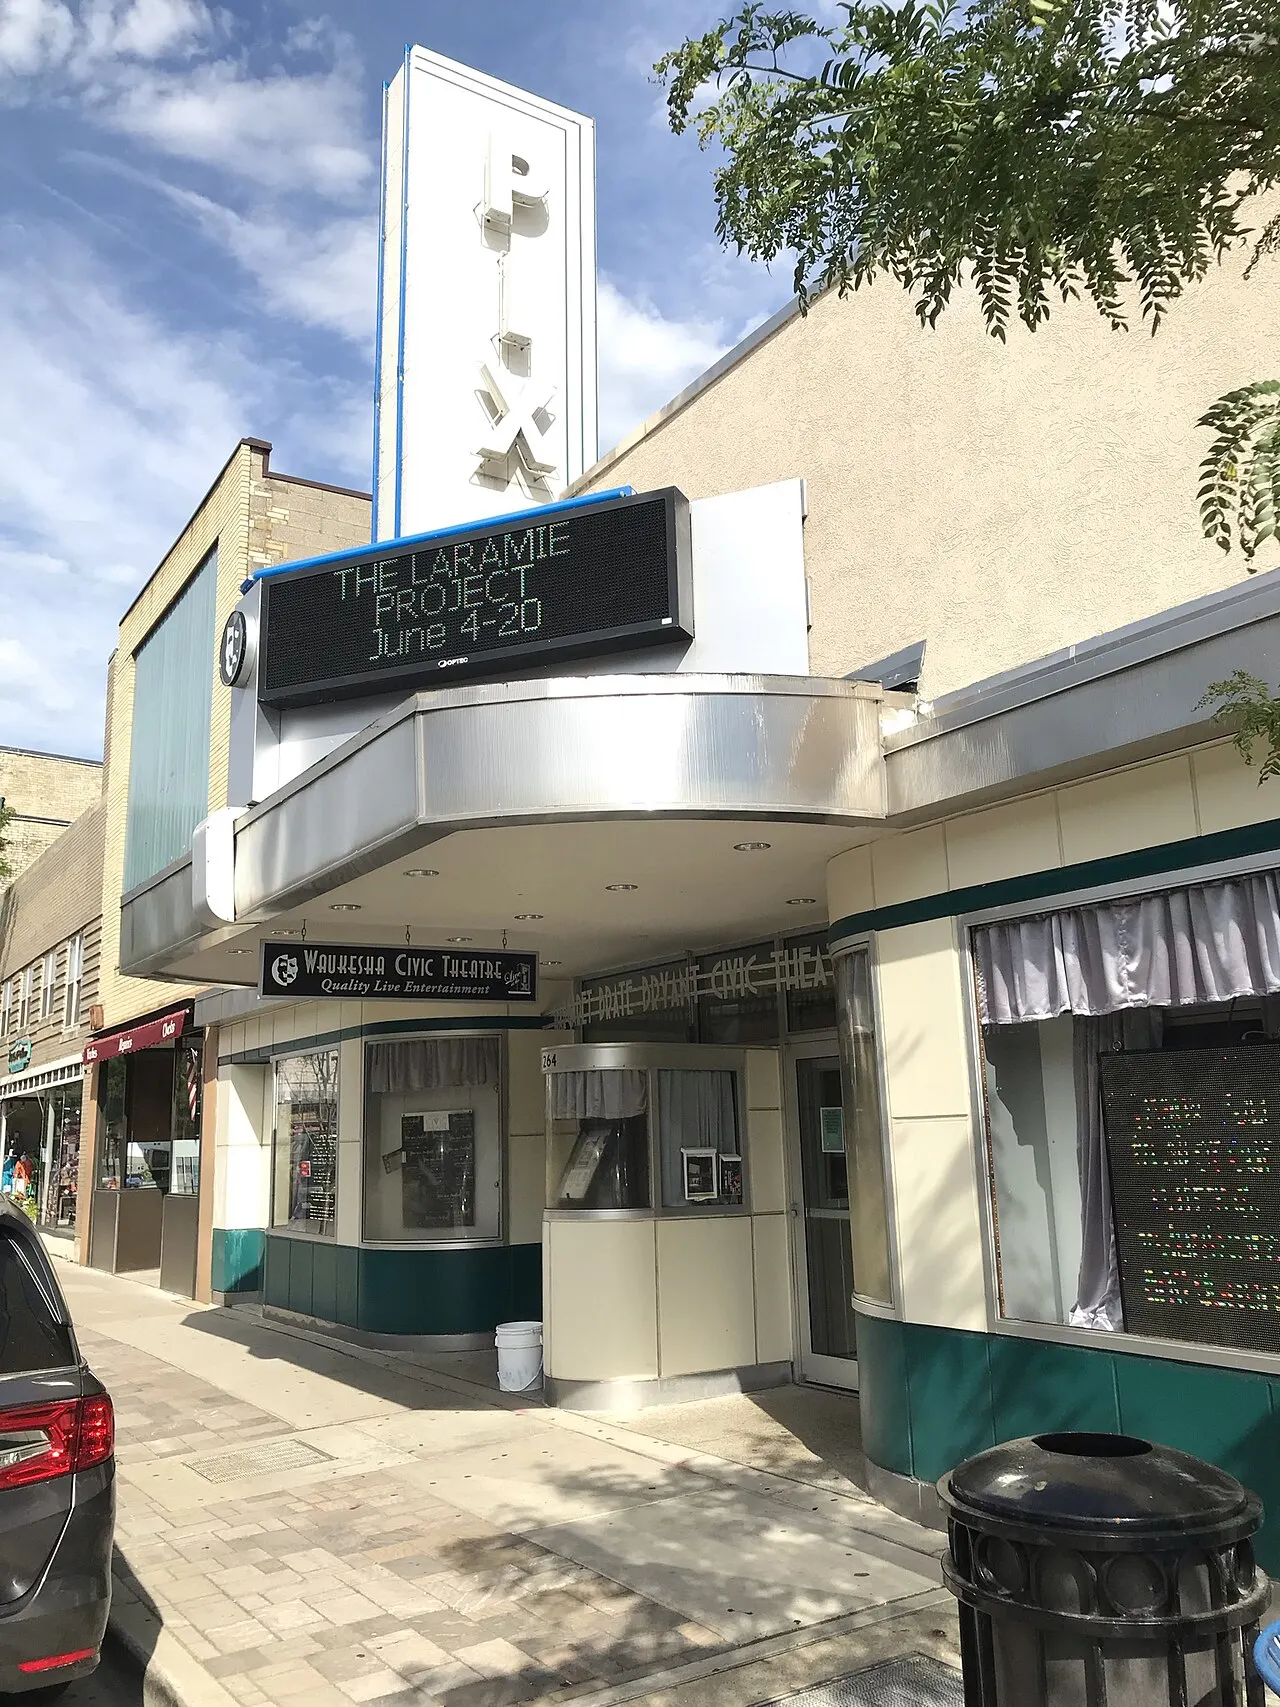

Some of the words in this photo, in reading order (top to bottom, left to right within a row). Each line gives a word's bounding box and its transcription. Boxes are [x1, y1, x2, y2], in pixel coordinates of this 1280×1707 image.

[334, 559, 398, 600] THE
[412, 522, 570, 585] LARAMIE
[375, 563, 535, 625] PROJECT
[369, 626, 447, 660] June
[460, 597, 542, 641] 4-20
[447, 657, 469, 666] OPTEC
[321, 978, 371, 994] Quality
[373, 980, 401, 993] Live
[403, 982, 491, 995] Entertainment
[394, 953, 434, 977] CIVIC
[441, 955, 502, 980] THEATRE
[711, 954, 758, 1000] CIVIC
[770, 944, 830, 992] THEA
[542, 1053, 557, 1069] 264
